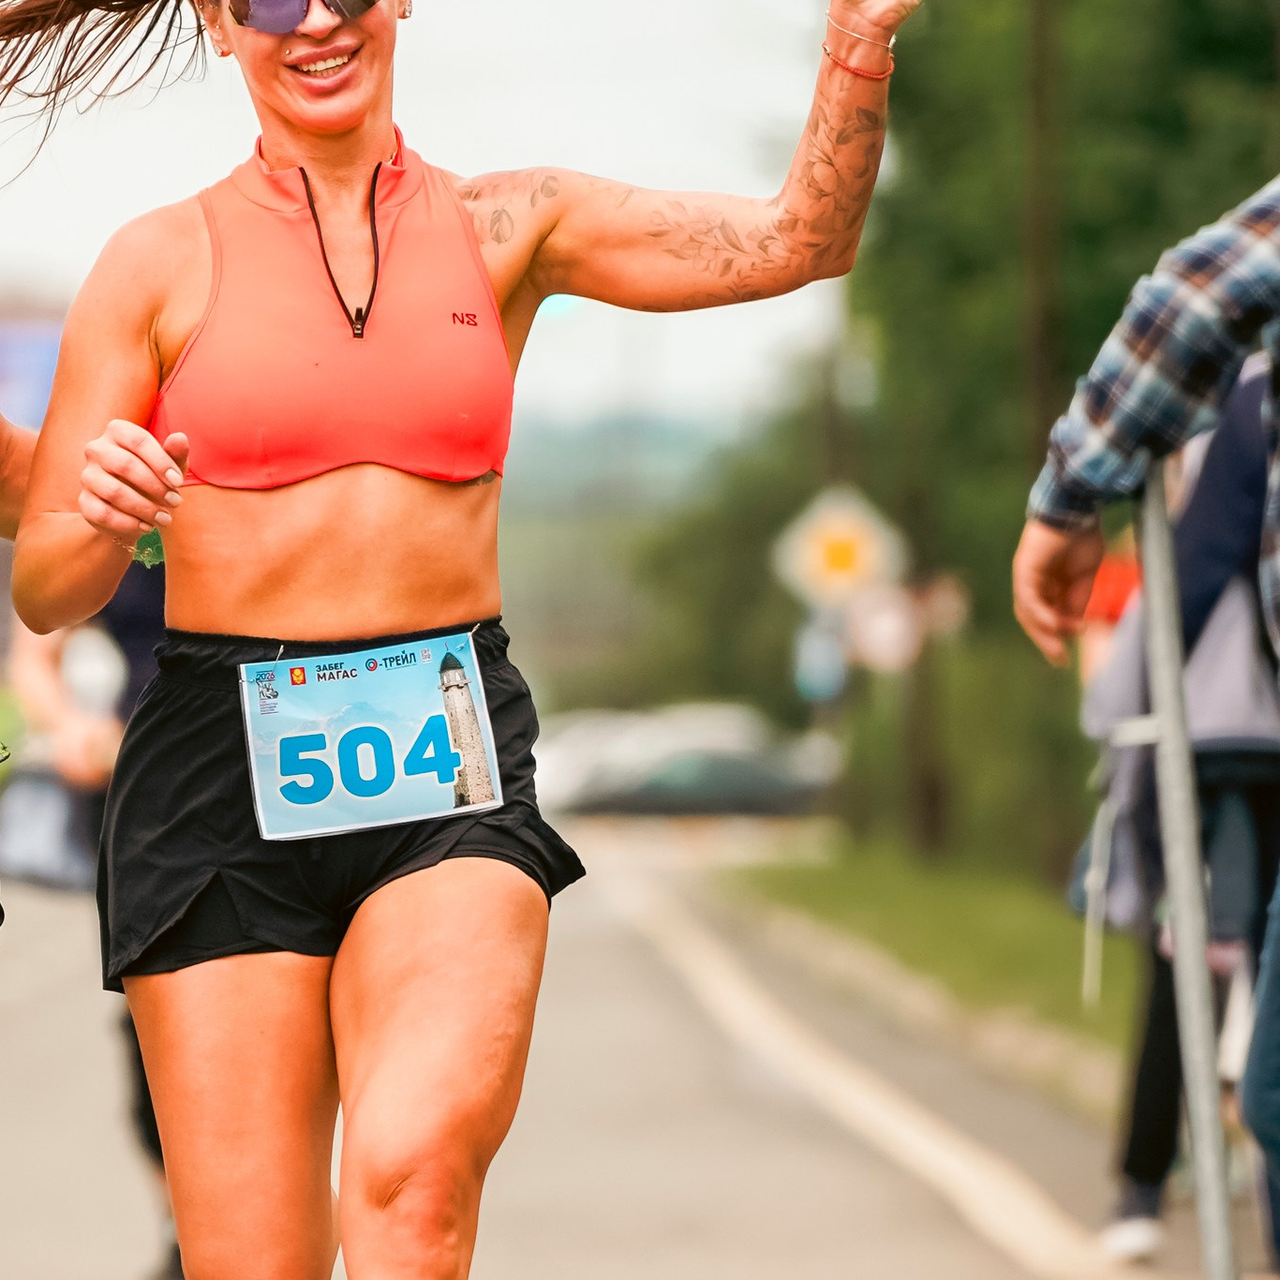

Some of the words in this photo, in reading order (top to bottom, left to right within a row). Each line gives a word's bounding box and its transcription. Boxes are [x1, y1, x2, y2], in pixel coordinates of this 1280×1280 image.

[452, 312, 478, 327] NS
[315, 662, 345, 673] ЗАБЕГ
[256, 672, 276, 680] 2026
[317, 668, 358, 682] МАГАС
[279, 714, 461, 805] 504
